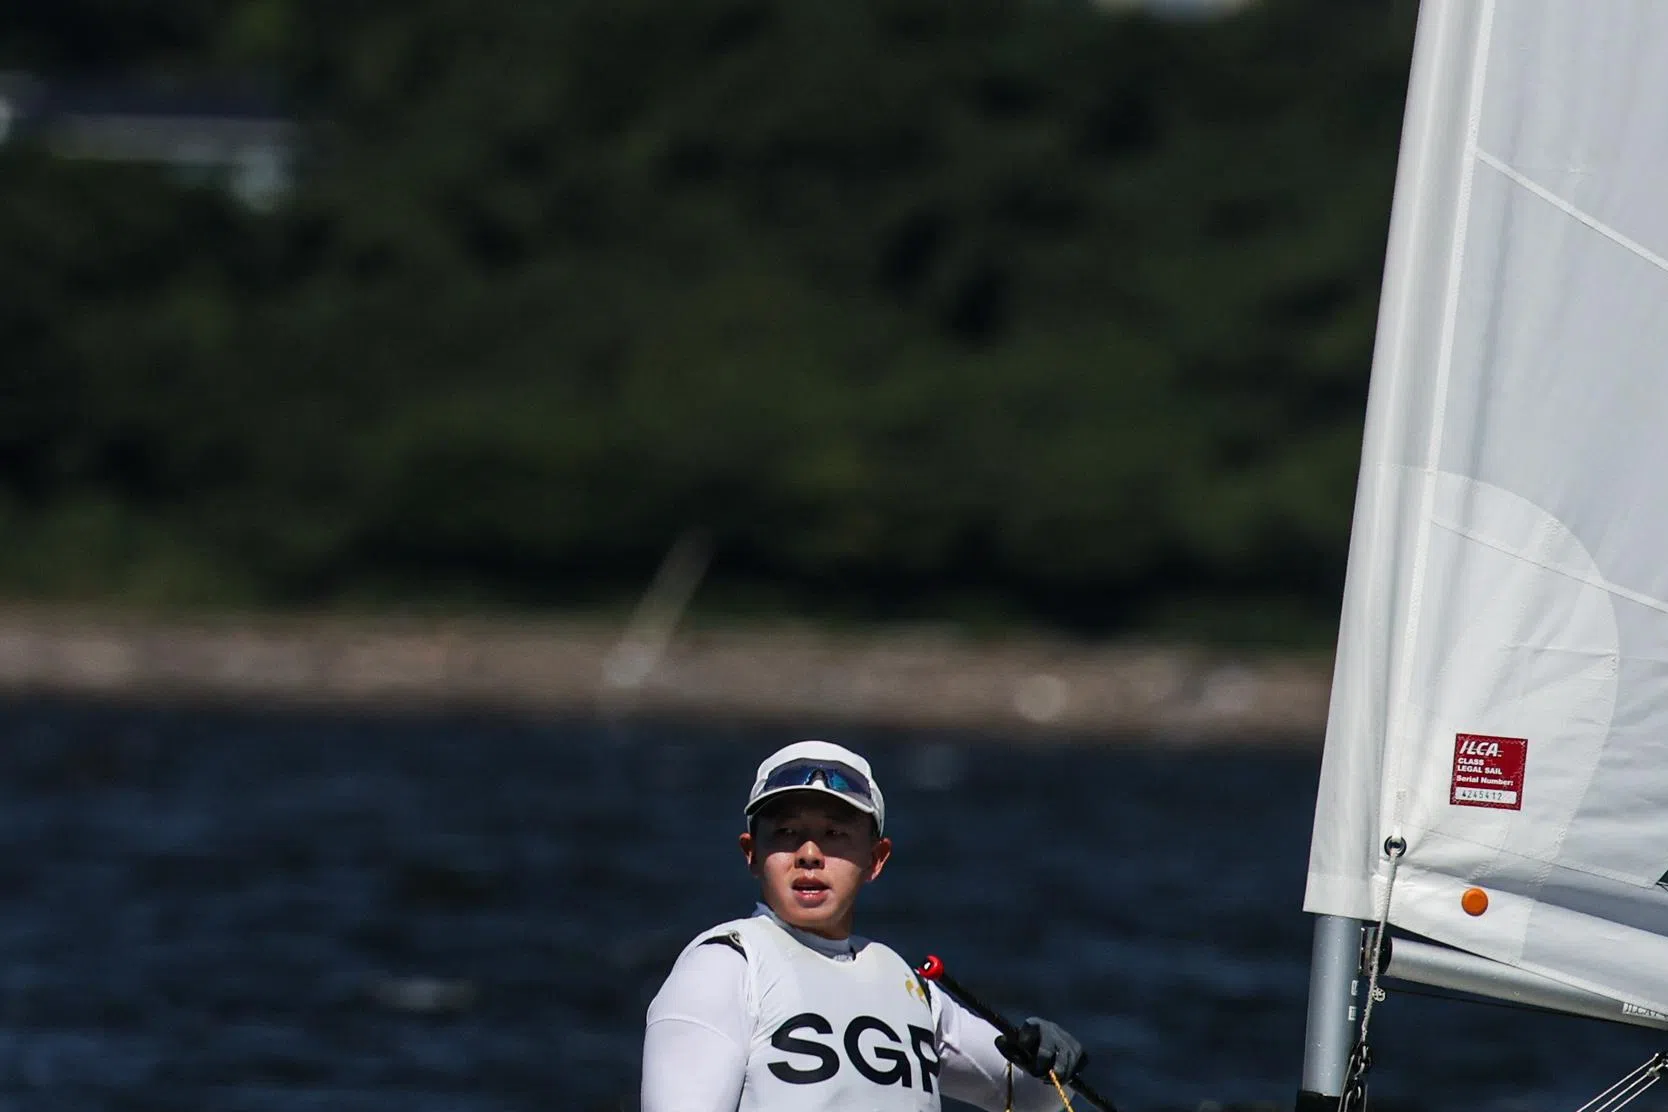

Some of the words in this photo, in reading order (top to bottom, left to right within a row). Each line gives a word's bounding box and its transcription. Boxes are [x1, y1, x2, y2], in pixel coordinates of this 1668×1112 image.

[1459, 740, 1499, 757] ILCA
[1457, 765, 1482, 773] LEGAL
[1456, 775, 1479, 783] Serial
[1481, 777, 1513, 786] Number:
[767, 1012, 940, 1094] SGP
